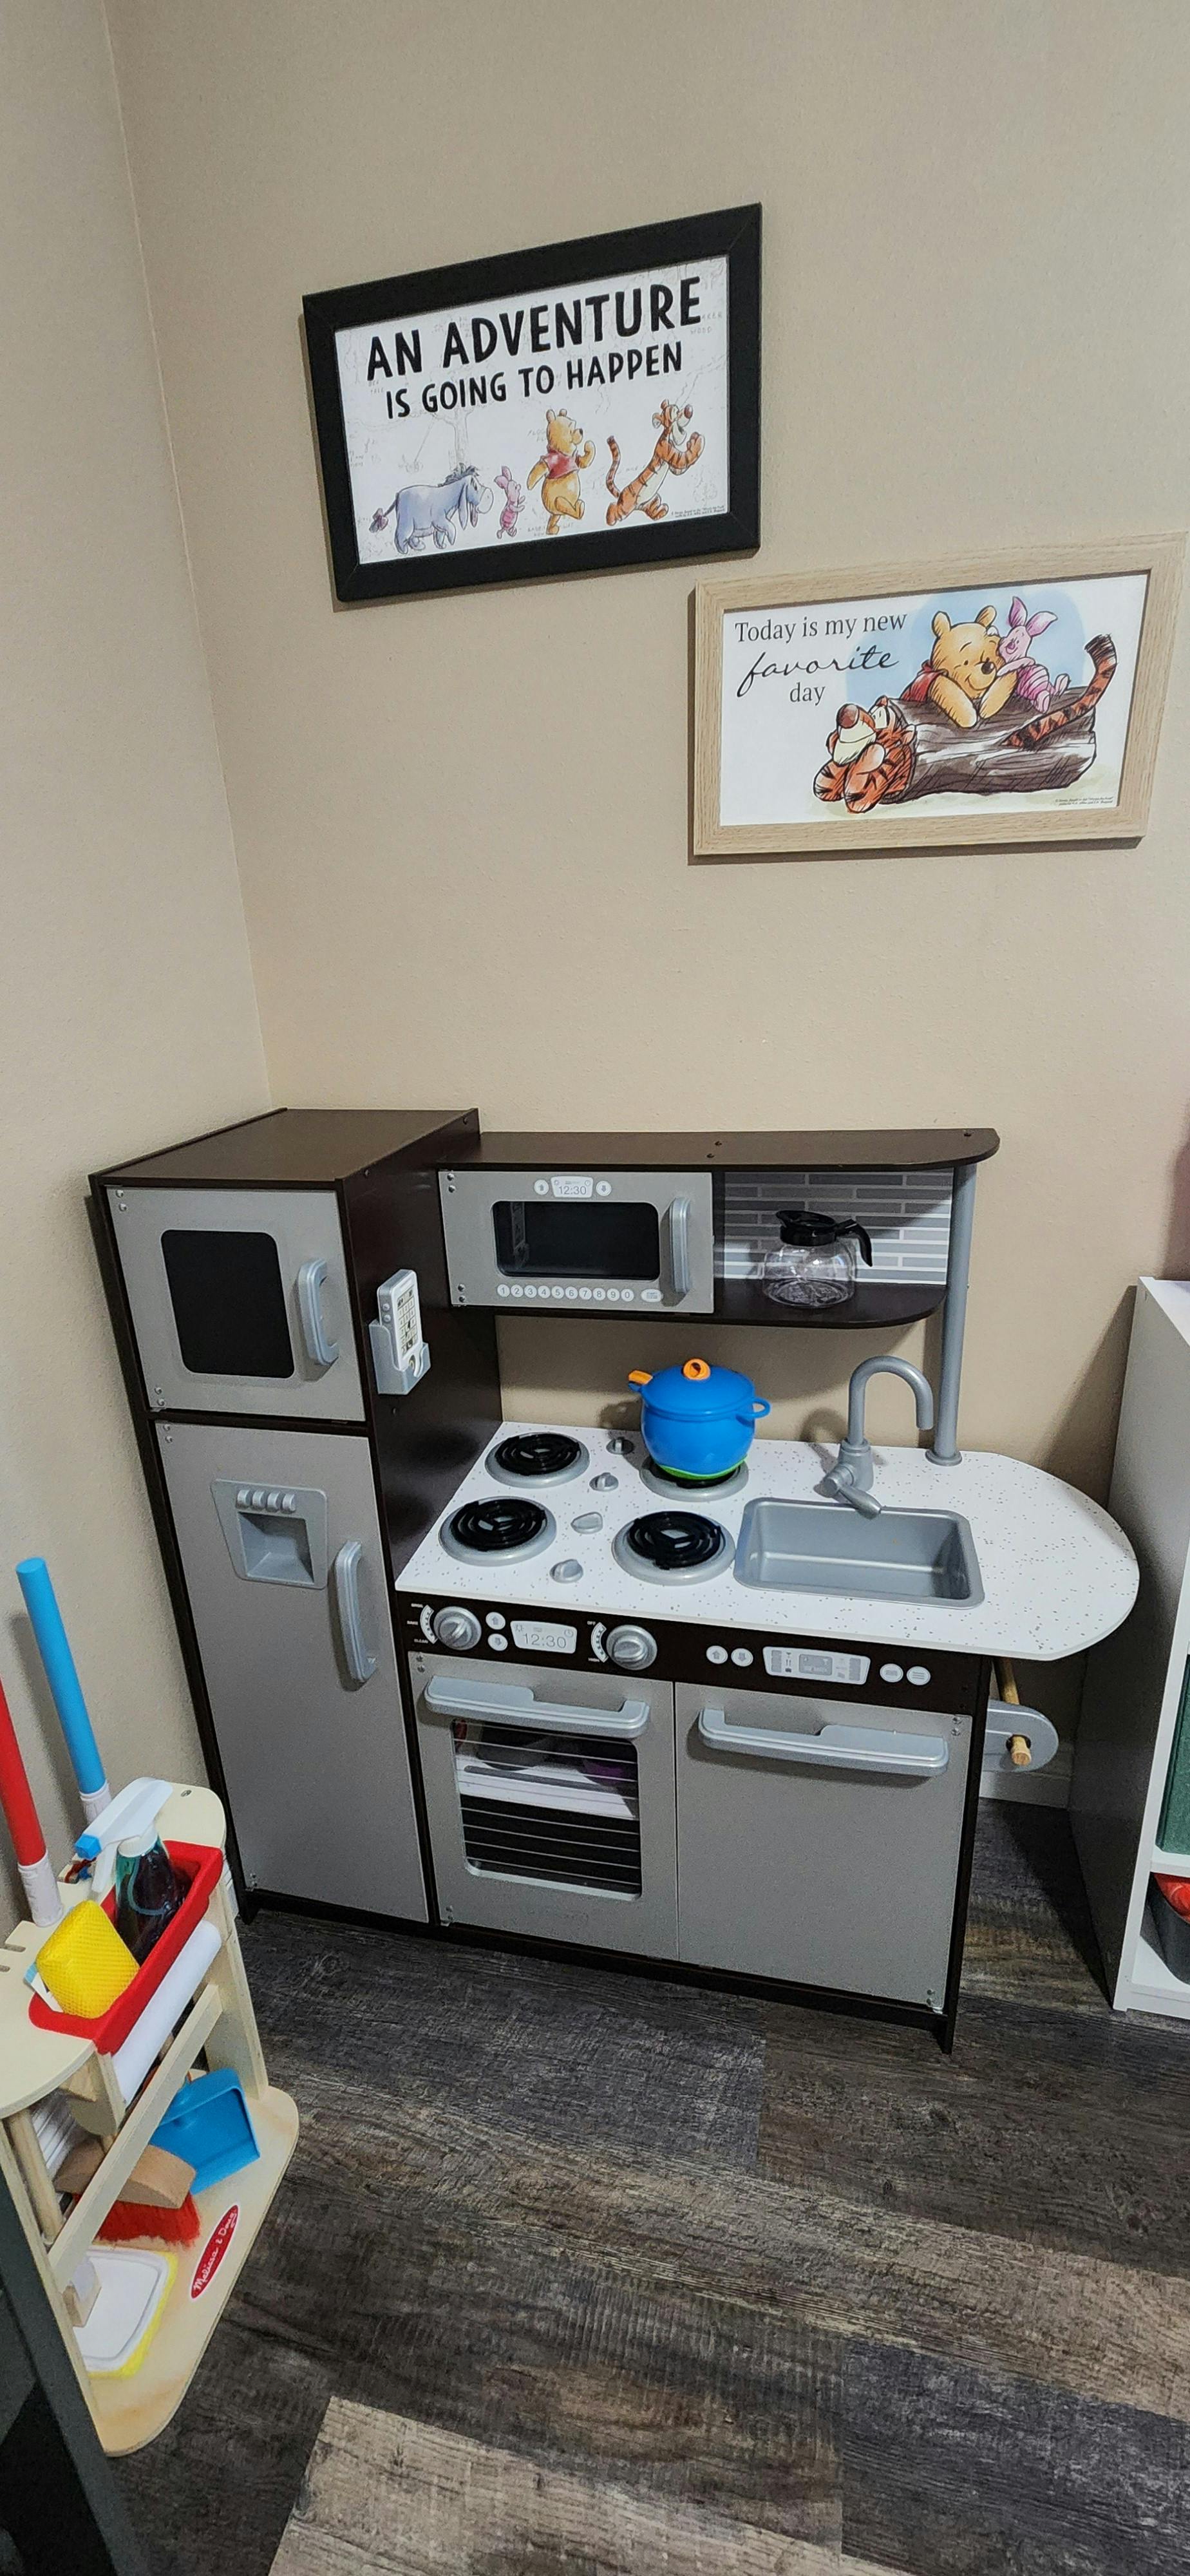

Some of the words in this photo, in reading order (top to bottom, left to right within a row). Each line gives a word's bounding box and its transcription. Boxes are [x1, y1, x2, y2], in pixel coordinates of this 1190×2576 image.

[367, 329, 422, 381] AN
[443, 276, 701, 368] ADVENTURE
[386, 388, 410, 419] IS
[422, 372, 506, 413] GOING
[518, 365, 554, 397] TO
[567, 341, 681, 390] HAPPEN
[735, 618, 796, 643] Today
[802, 617, 818, 637] is
[825, 618, 857, 639] my
[863, 614, 907, 632] new
[737, 645, 900, 697] favorite
[789, 682, 826, 706] day
[558, 1186, 587, 1195] 12:30
[522, 1633, 567, 1647] 12:30
[193, 2248, 218, 2290] Melissa
[218, 2213, 237, 2237] Doug
